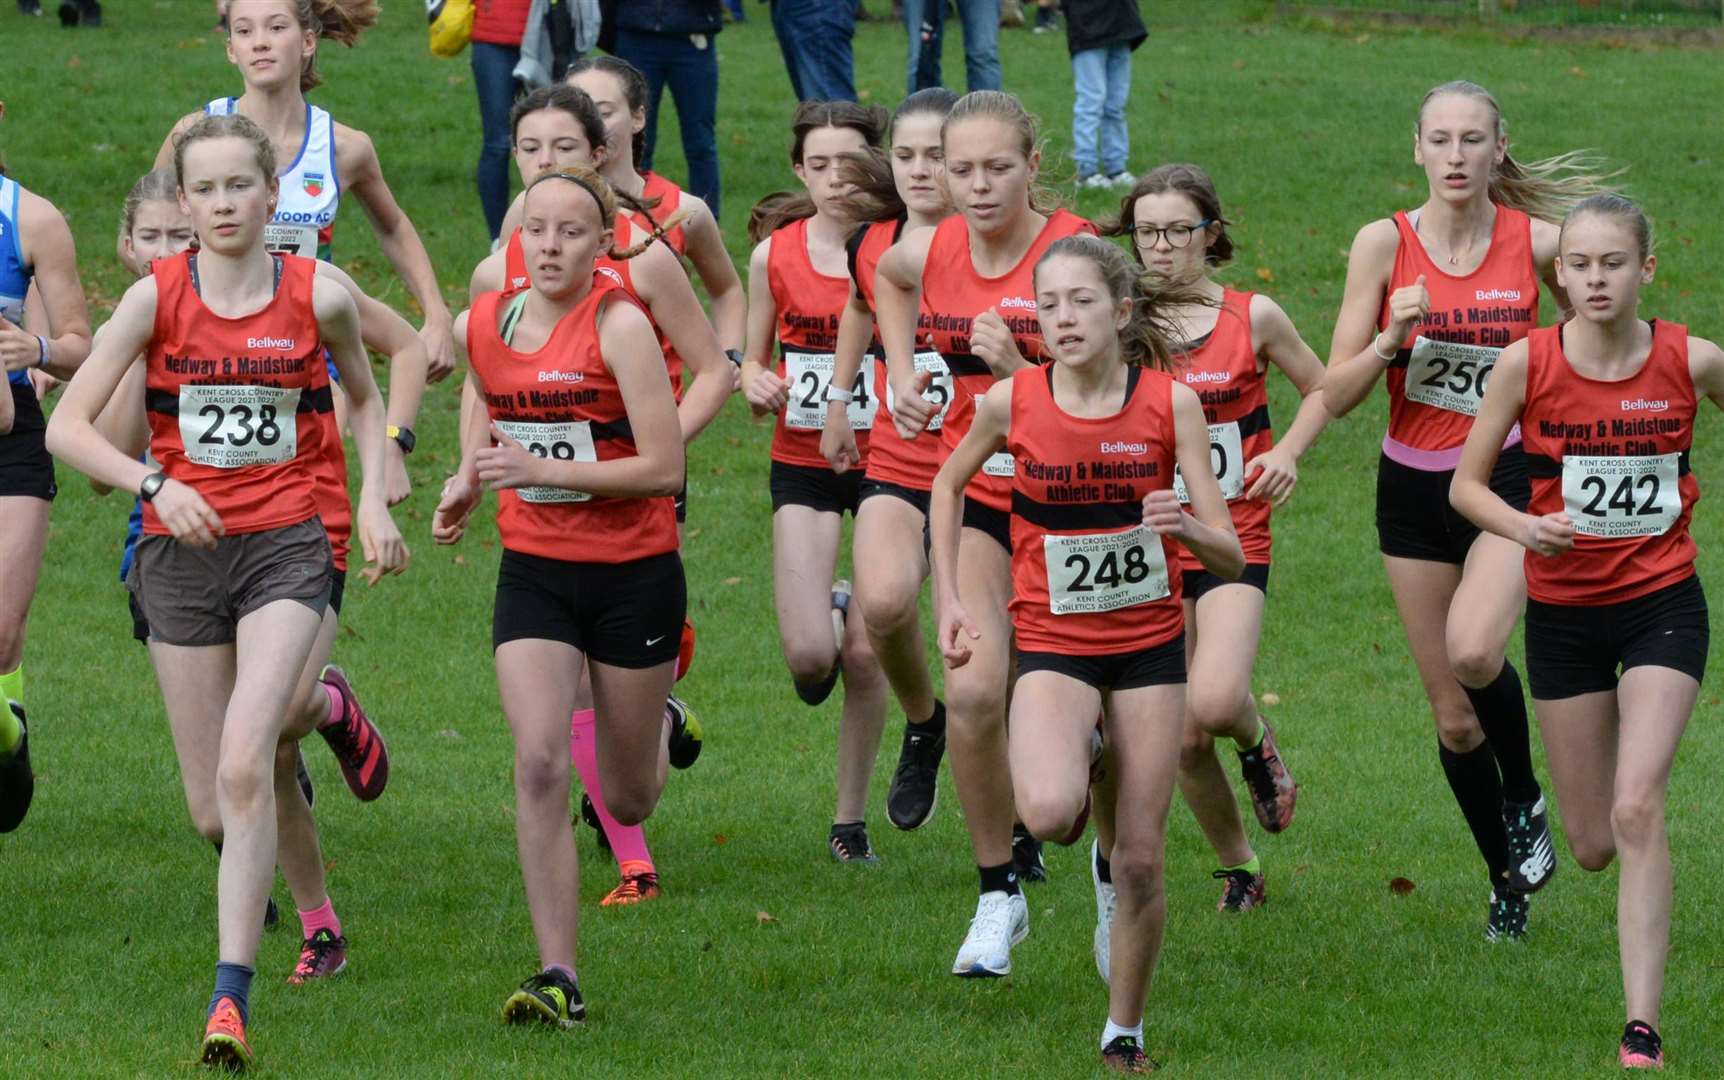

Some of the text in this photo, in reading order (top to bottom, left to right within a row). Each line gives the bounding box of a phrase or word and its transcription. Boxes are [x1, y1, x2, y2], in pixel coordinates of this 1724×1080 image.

[1475, 288, 1521, 302] Bellway
[1000, 296, 1037, 312] Bellwa
[1454, 310, 1463, 324] &
[1468, 306, 1532, 323] Maidstone
[932, 312, 974, 334] Medway
[1481, 326, 1510, 344] Club
[247, 336, 295, 351] Bellway
[1430, 344, 1500, 357] KENT CROSS COUNT
[1435, 352, 1496, 363] LEAGUE 2021-202
[164, 354, 217, 376] Medway
[222, 357, 233, 373] &
[538, 370, 584, 384] Bellway
[1186, 371, 1230, 384] Bellway
[219, 388, 246, 396] CROSS
[248, 388, 284, 397] COUNTRY
[518, 390, 528, 408] &
[529, 388, 600, 408] Maidstone
[1425, 390, 1474, 406] KENT COUNTY
[1442, 402, 1478, 414] ASSOCIAT
[1621, 398, 1669, 412] Bellway
[198, 404, 281, 446] 238
[519, 425, 538, 433] CROSS
[538, 425, 572, 433] COUNTRY
[1540, 420, 1592, 441] Medway
[1597, 421, 1607, 438] &
[1612, 417, 1680, 437] Maidstone
[208, 448, 259, 458] KENT COUNTY
[1100, 442, 1148, 456] Bellway
[1625, 440, 1657, 456] Club
[225, 457, 277, 465] ASSOCIATION
[1628, 458, 1664, 466] COUNTRY
[1024, 459, 1072, 484] Medway
[1076, 462, 1086, 479] &
[1091, 460, 1159, 480] Maidstone
[1618, 466, 1656, 474] 2021-2022
[534, 492, 583, 500] ASSOCIATION
[1046, 483, 1135, 502] Athletic Club
[1580, 474, 1663, 517] 242
[1608, 520, 1641, 528] COUNTY
[1608, 527, 1662, 535] ASSOCIATION
[1082, 536, 1109, 545] CROSS
[1110, 529, 1144, 543] COUNTRY
[1069, 538, 1140, 554] LEAGUE 2021-2022
[1064, 546, 1150, 592] 248
[1056, 593, 1151, 612] ATHLETICS ASSOCIATION
[1076, 590, 1129, 603] KENT COUNTY
